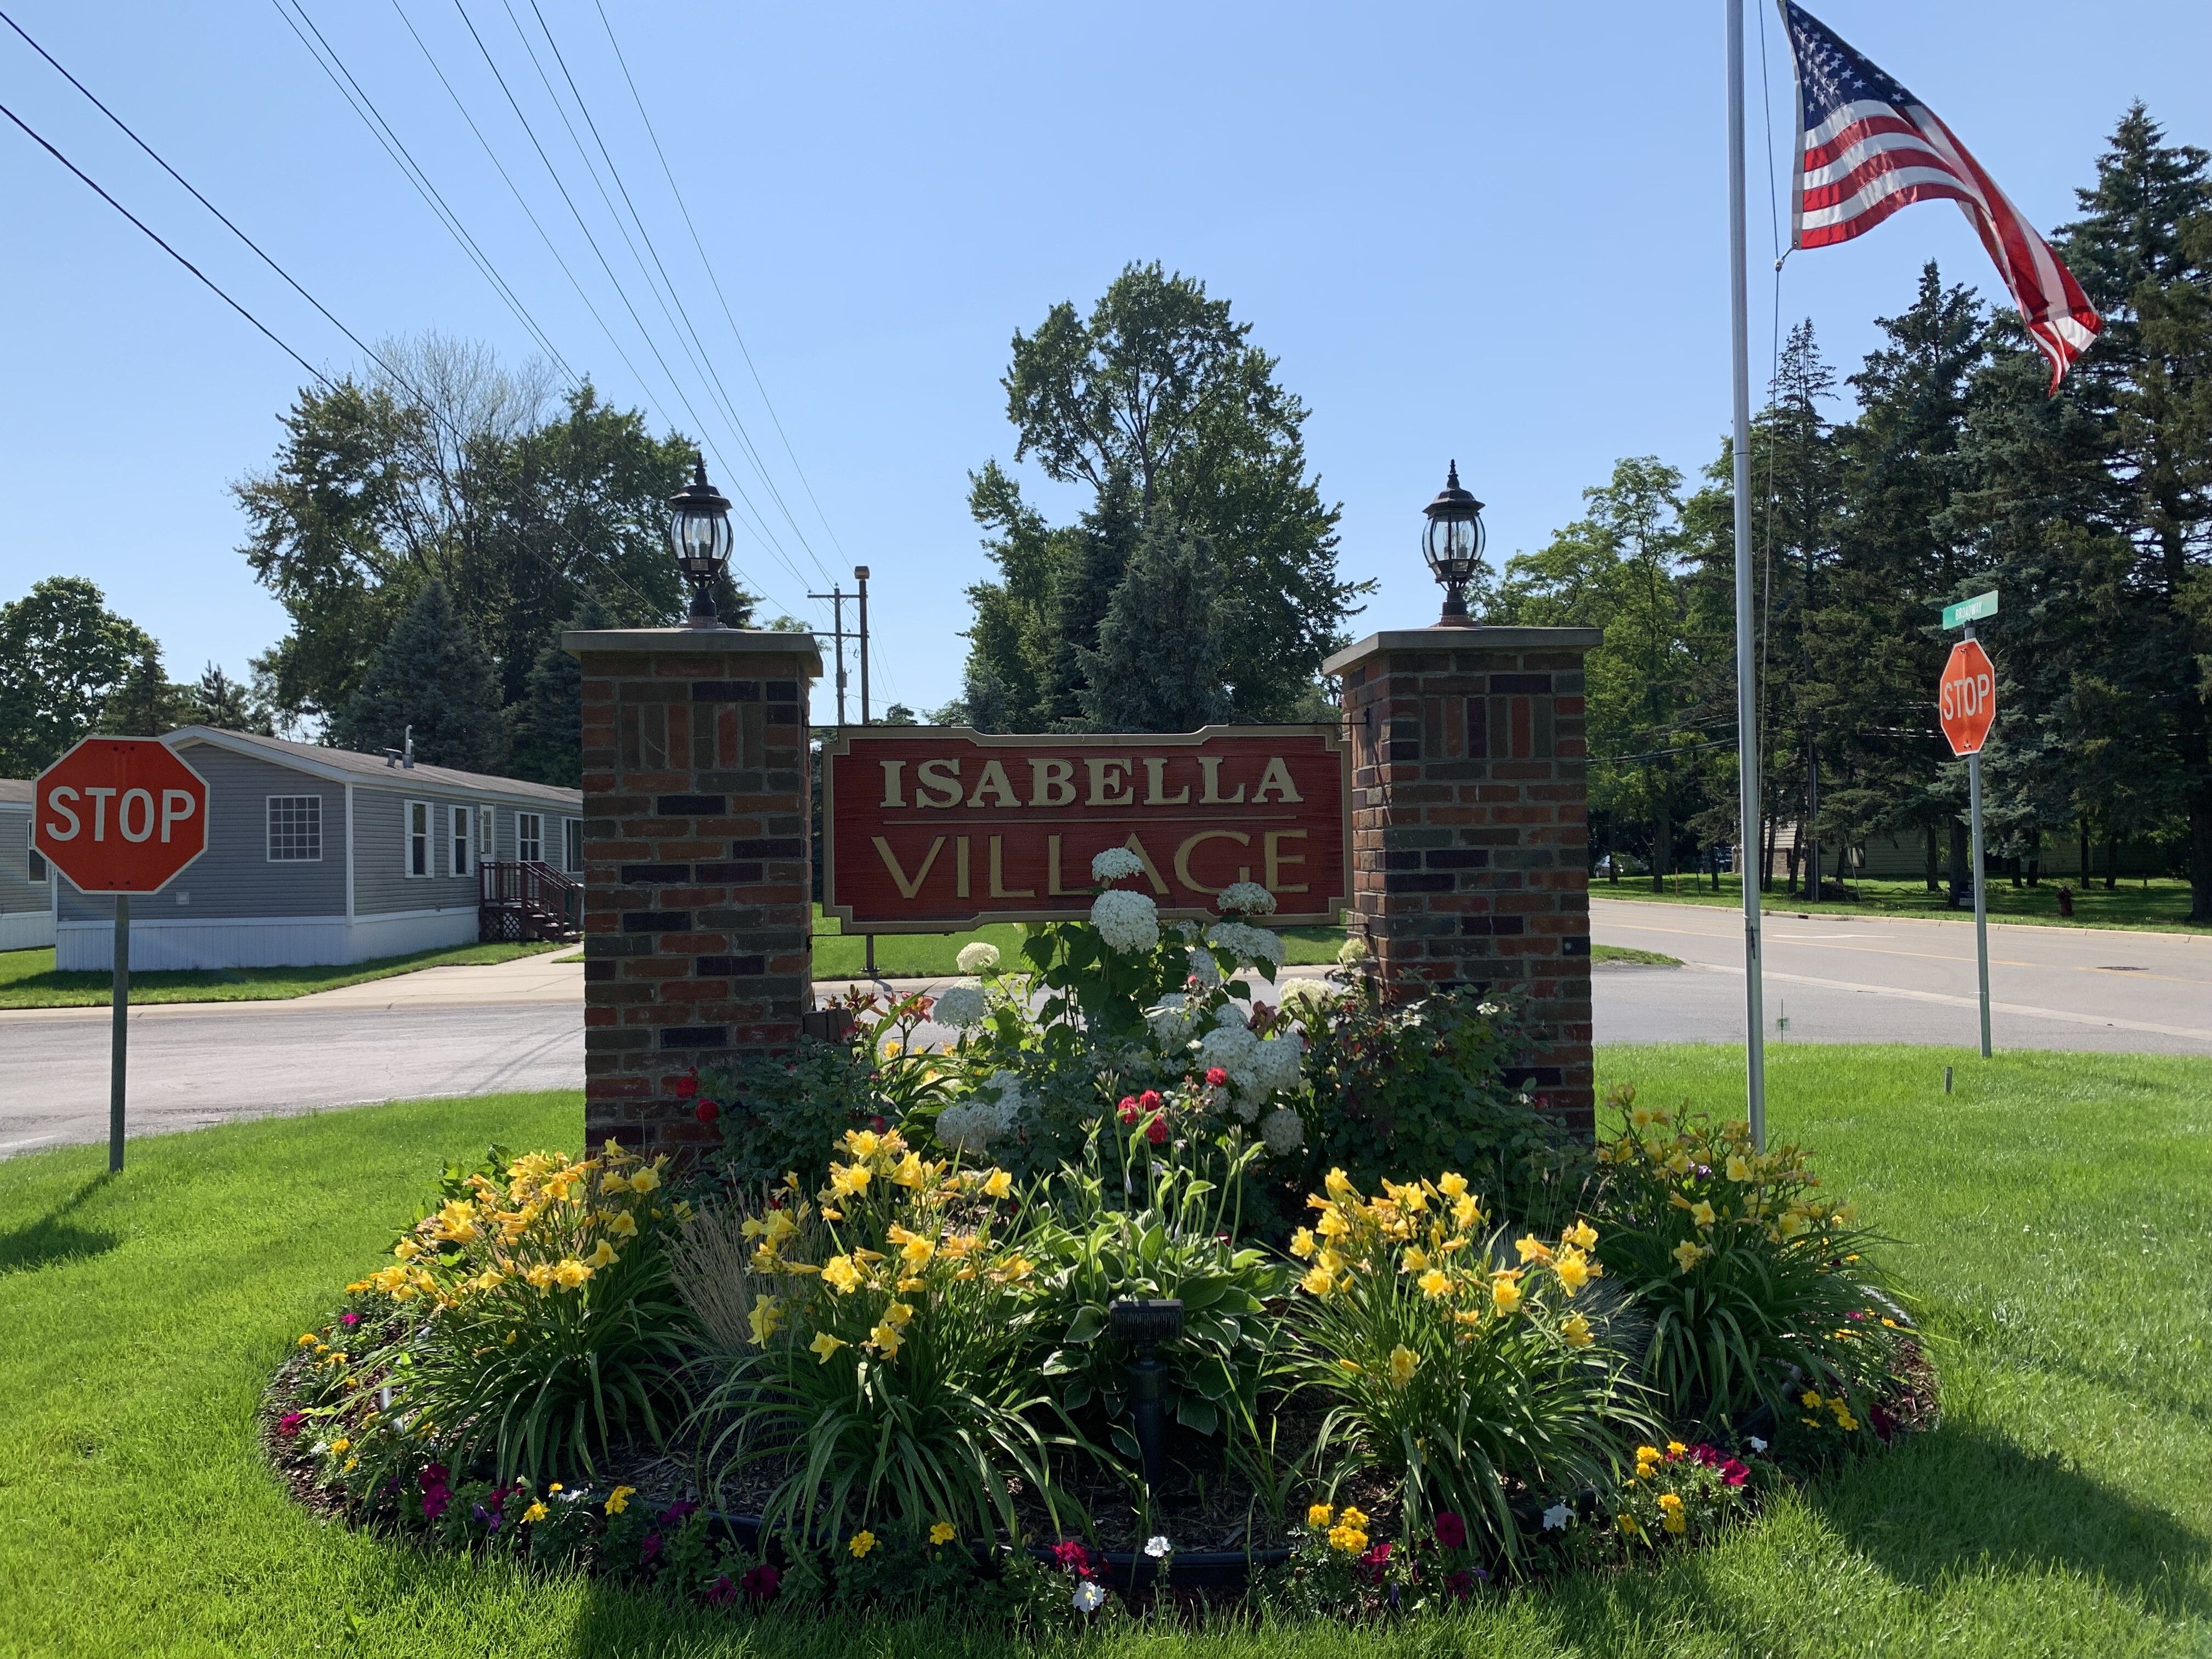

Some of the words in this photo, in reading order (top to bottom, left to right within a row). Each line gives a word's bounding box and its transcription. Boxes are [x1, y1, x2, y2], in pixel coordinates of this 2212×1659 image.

[1955, 601, 1982, 620] BROADWAY
[1943, 674, 1990, 720] STOP
[879, 757, 1305, 809] ISABELLA
[46, 786, 195, 843] STOP
[871, 829, 1309, 899] VILLAGE
